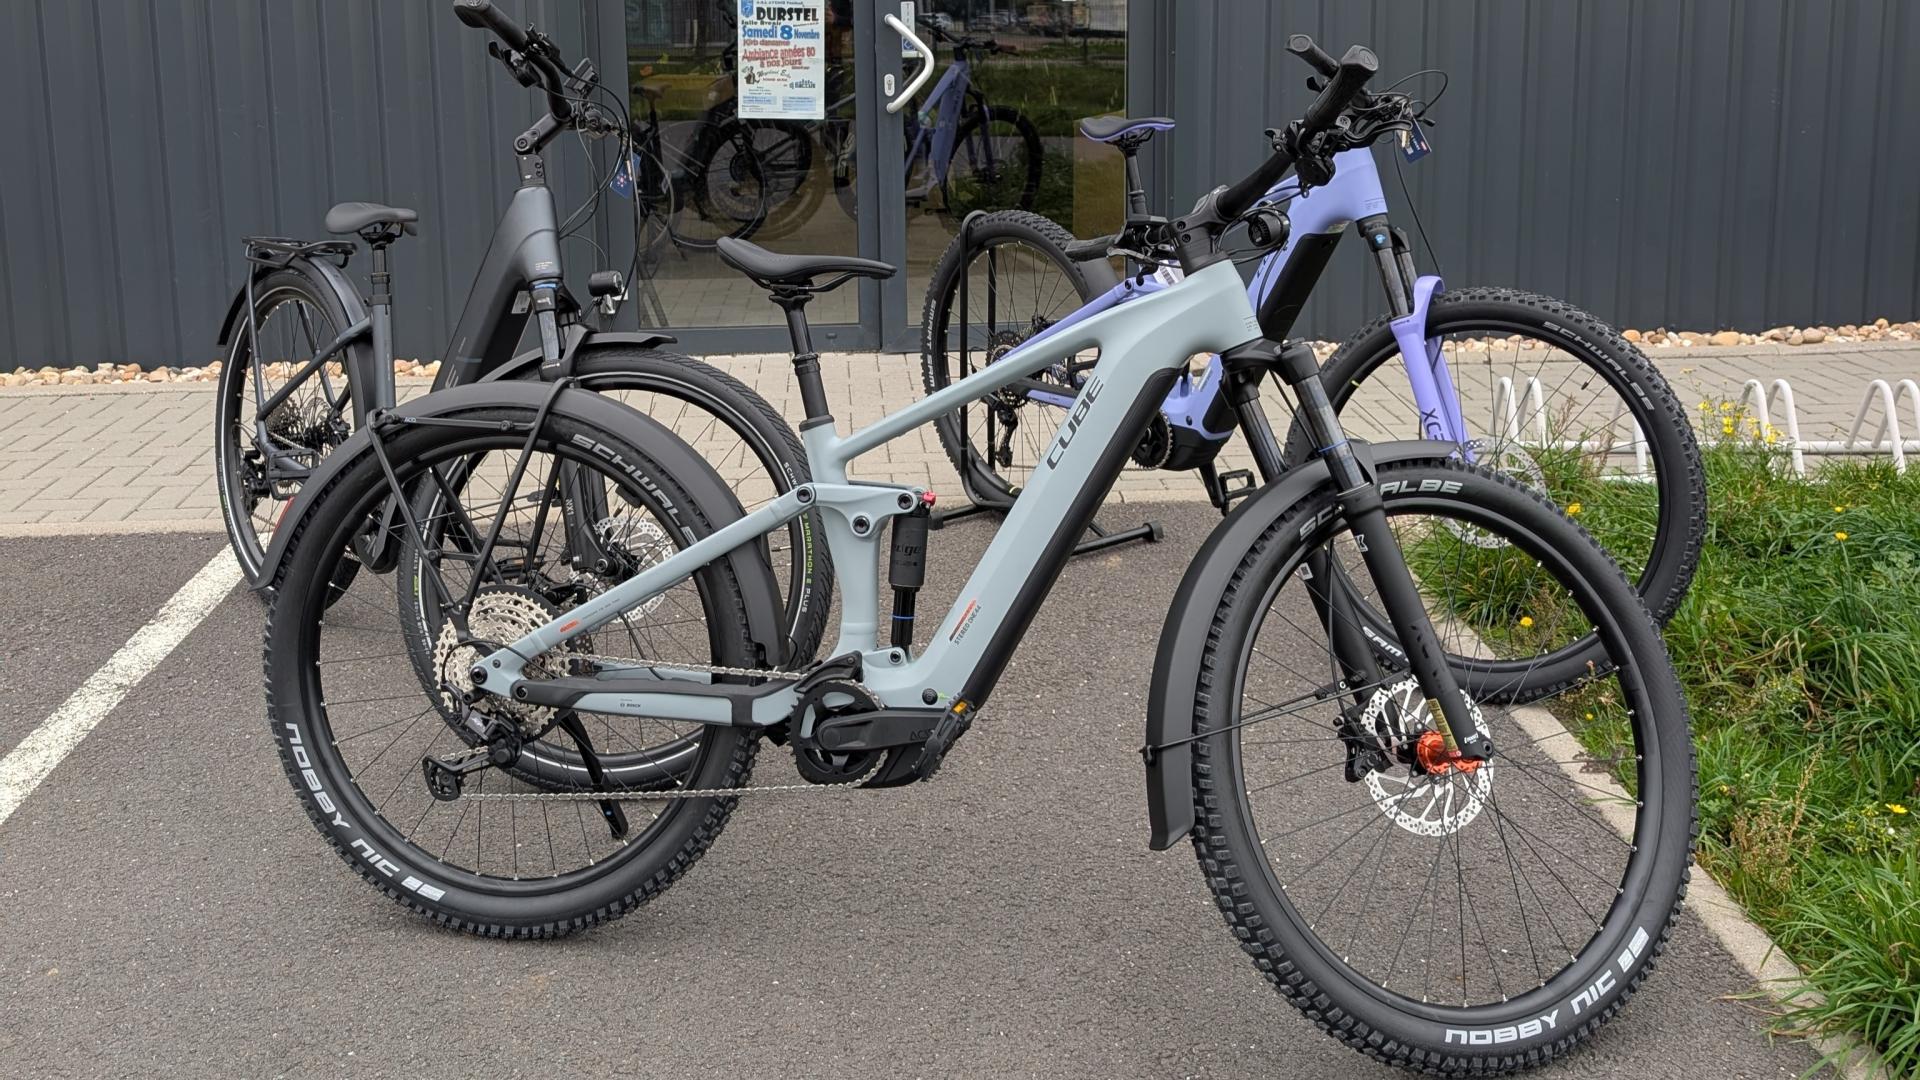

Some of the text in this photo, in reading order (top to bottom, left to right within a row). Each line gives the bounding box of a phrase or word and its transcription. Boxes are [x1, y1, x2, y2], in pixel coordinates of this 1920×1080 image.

[742, 24, 820, 40] Samedi 8 Novembre
[756, 7, 819, 21] DURSTEL
[742, 45, 816, 61] Ambiance années 80
[781, 58, 802, 68] jours
[926, 298, 937, 387] SMART SAM
[1543, 321, 1655, 411] SCHWALBE
[1046, 375, 1104, 470] CUBE
[570, 433, 699, 547] SCHWALB
[784, 461, 800, 489] SCHW
[803, 521, 813, 575] MARATHON
[801, 587, 811, 613] PLUS
[954, 622, 970, 645] STEREO
[285, 722, 400, 877] NOBBY NIC
[1445, 969, 1617, 1045] NOBBY NIC
